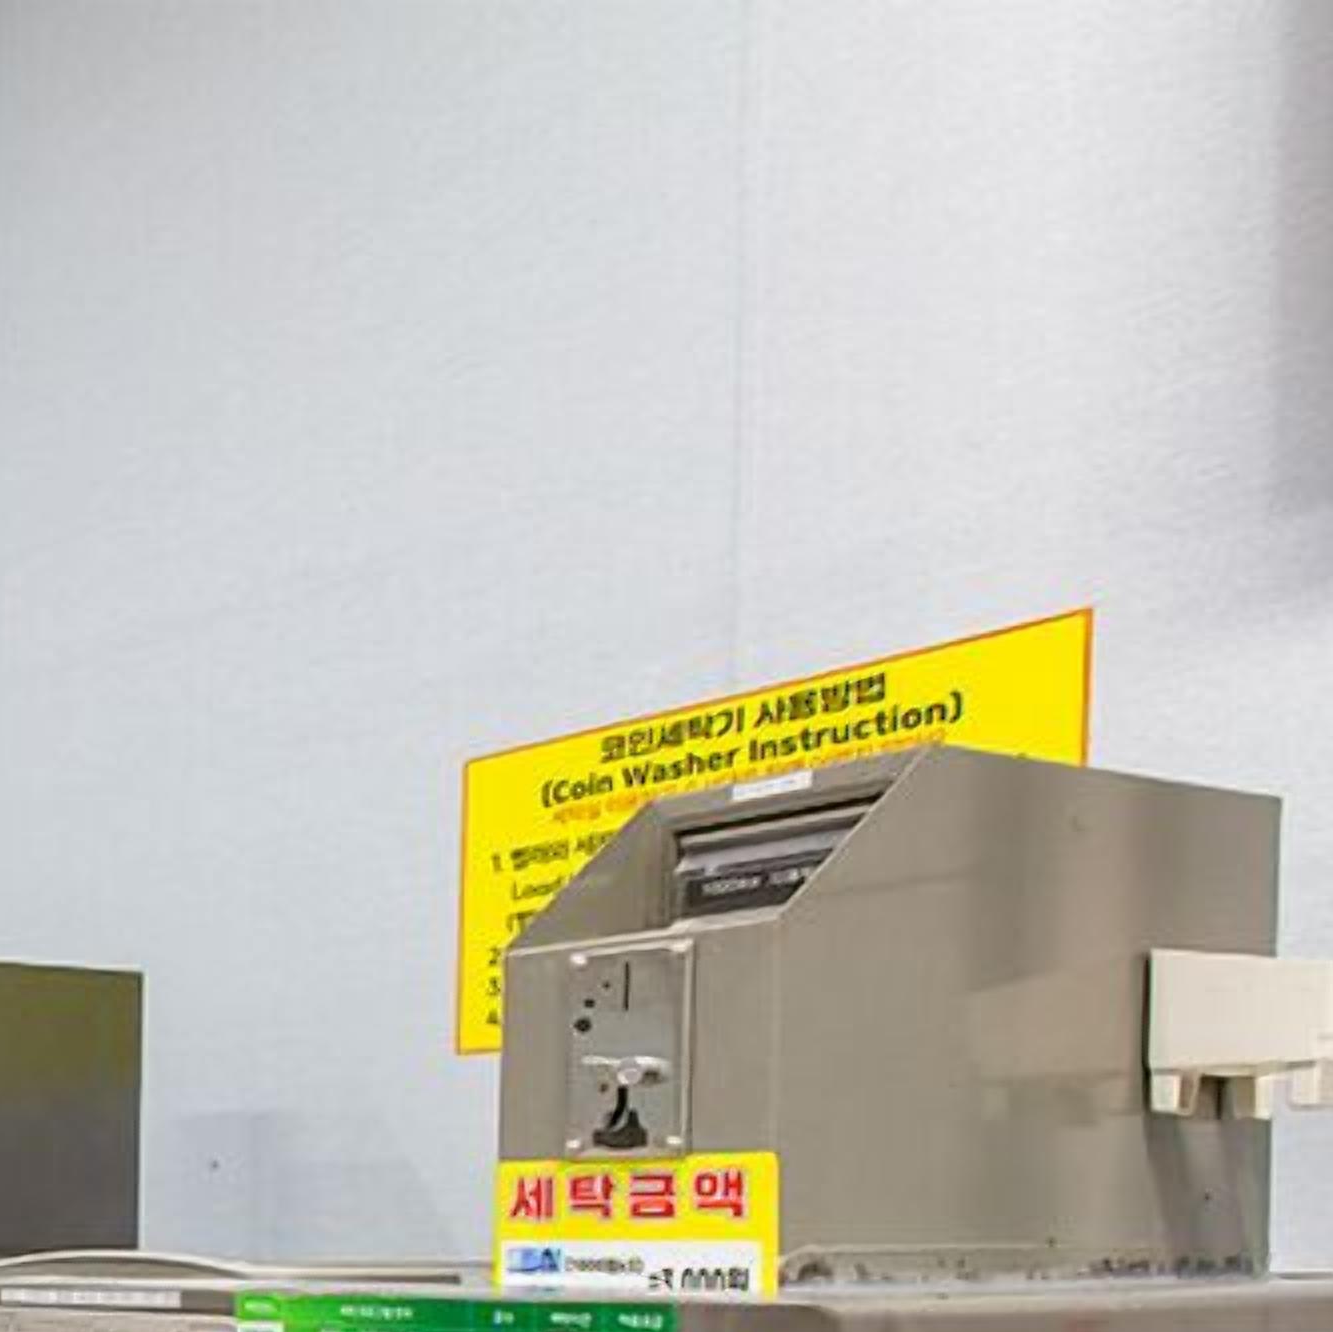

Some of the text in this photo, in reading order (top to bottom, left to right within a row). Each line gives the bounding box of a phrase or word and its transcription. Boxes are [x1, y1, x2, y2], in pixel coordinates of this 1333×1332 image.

[541, 774, 614, 808] (Coin
[621, 748, 737, 788] Washer
[749, 689, 964, 763] Instruction)
[510, 1162, 746, 1222] 세탁금액
